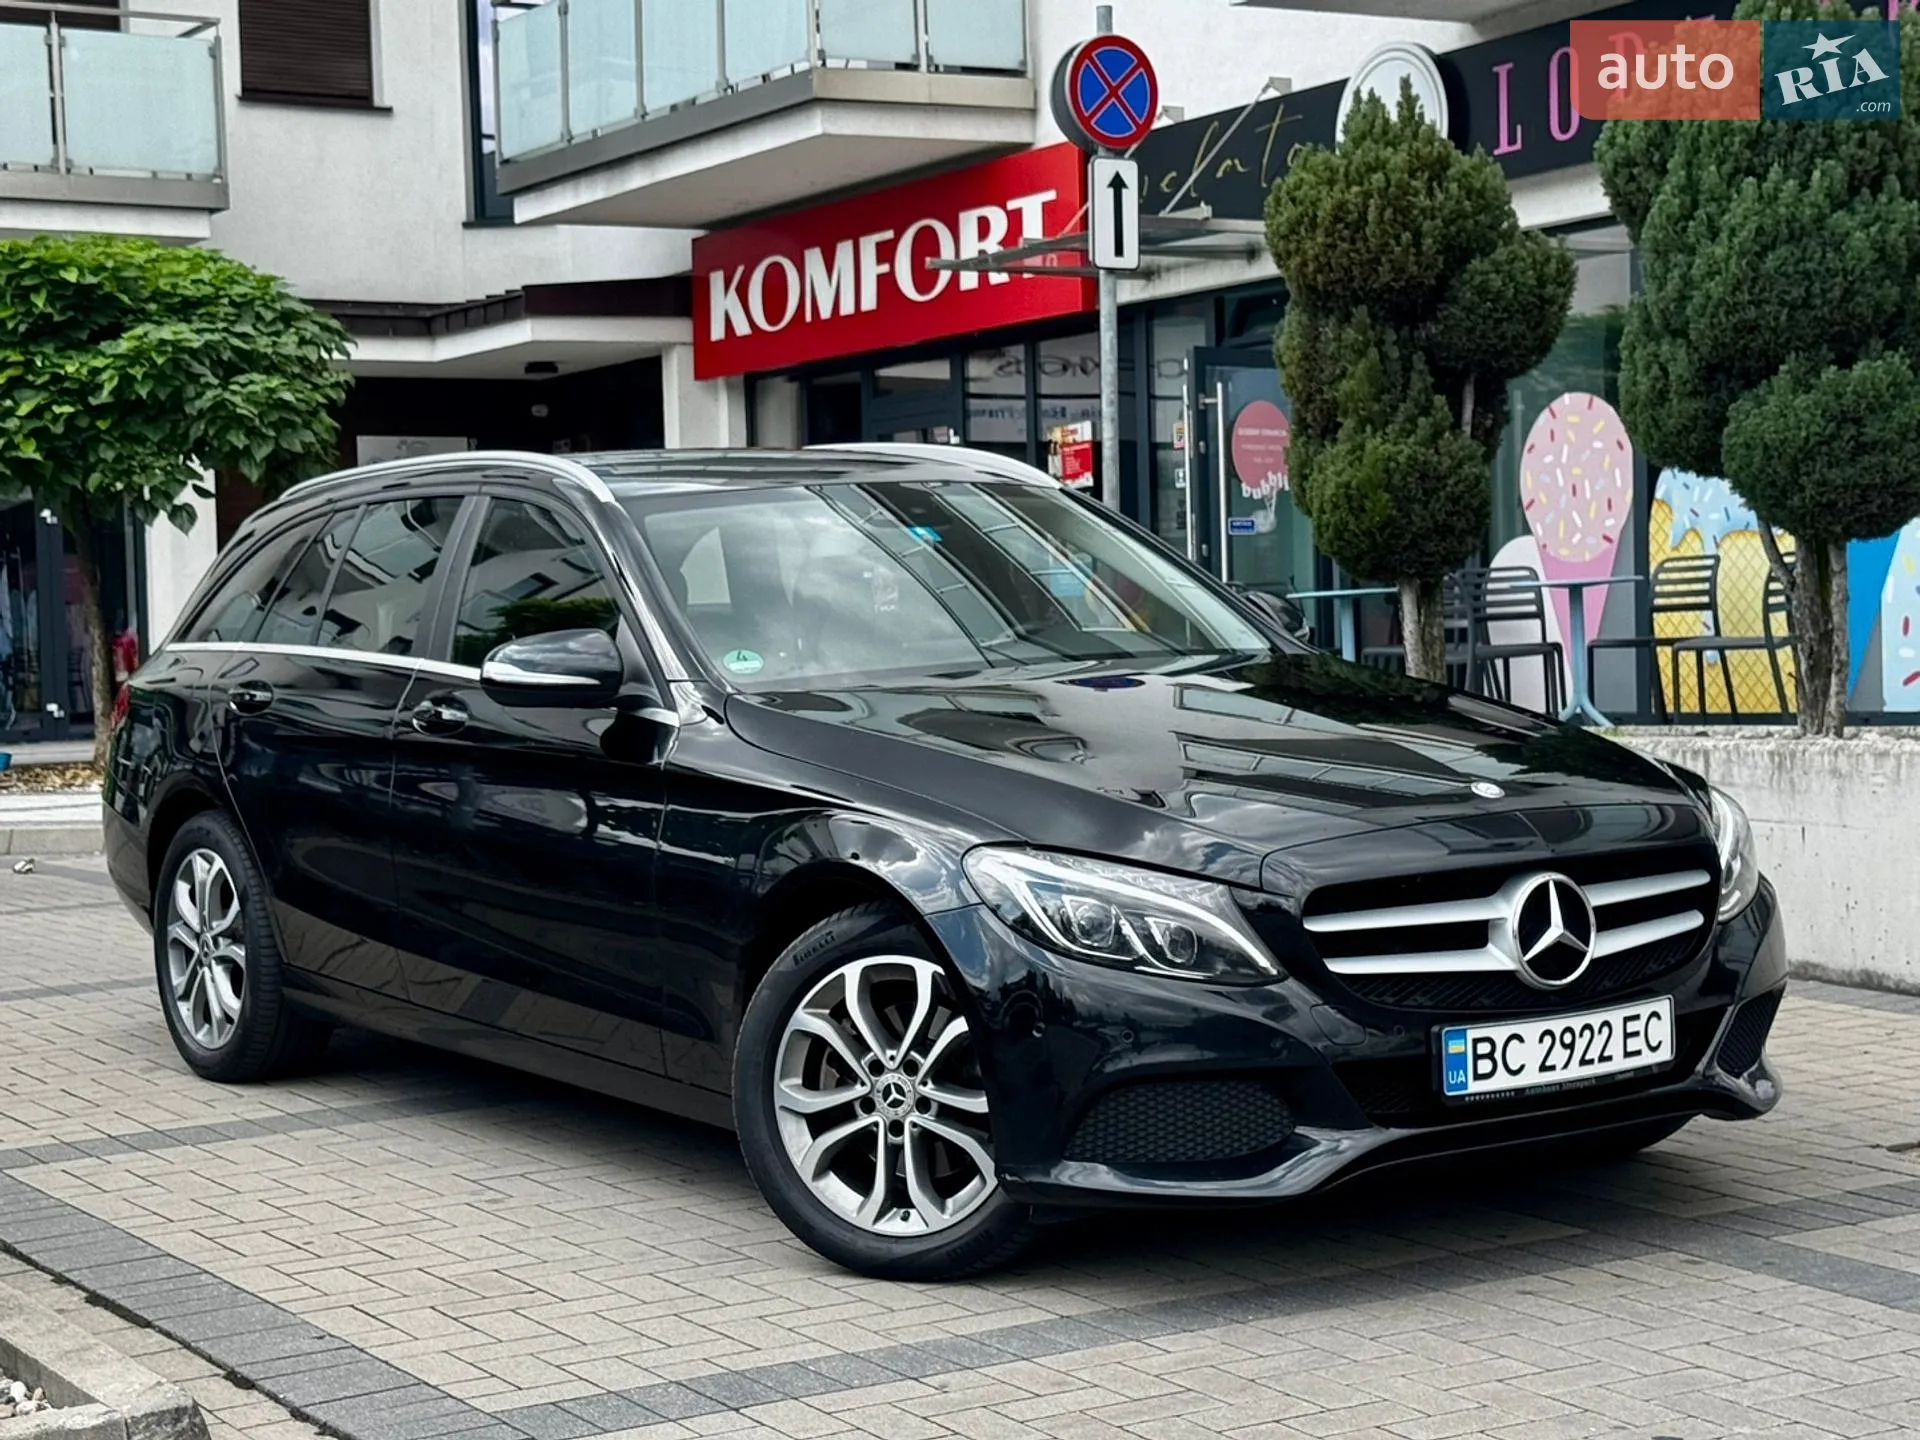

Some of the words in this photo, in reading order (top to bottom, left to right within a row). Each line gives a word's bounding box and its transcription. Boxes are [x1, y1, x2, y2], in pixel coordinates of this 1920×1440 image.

[709, 190, 1057, 342] KOMFORT
[1449, 1070, 1466, 1084] UA
[1472, 1032, 1526, 1081] BC
[1538, 1020, 1613, 1072] 2922
[1622, 1011, 1663, 1058] EC
